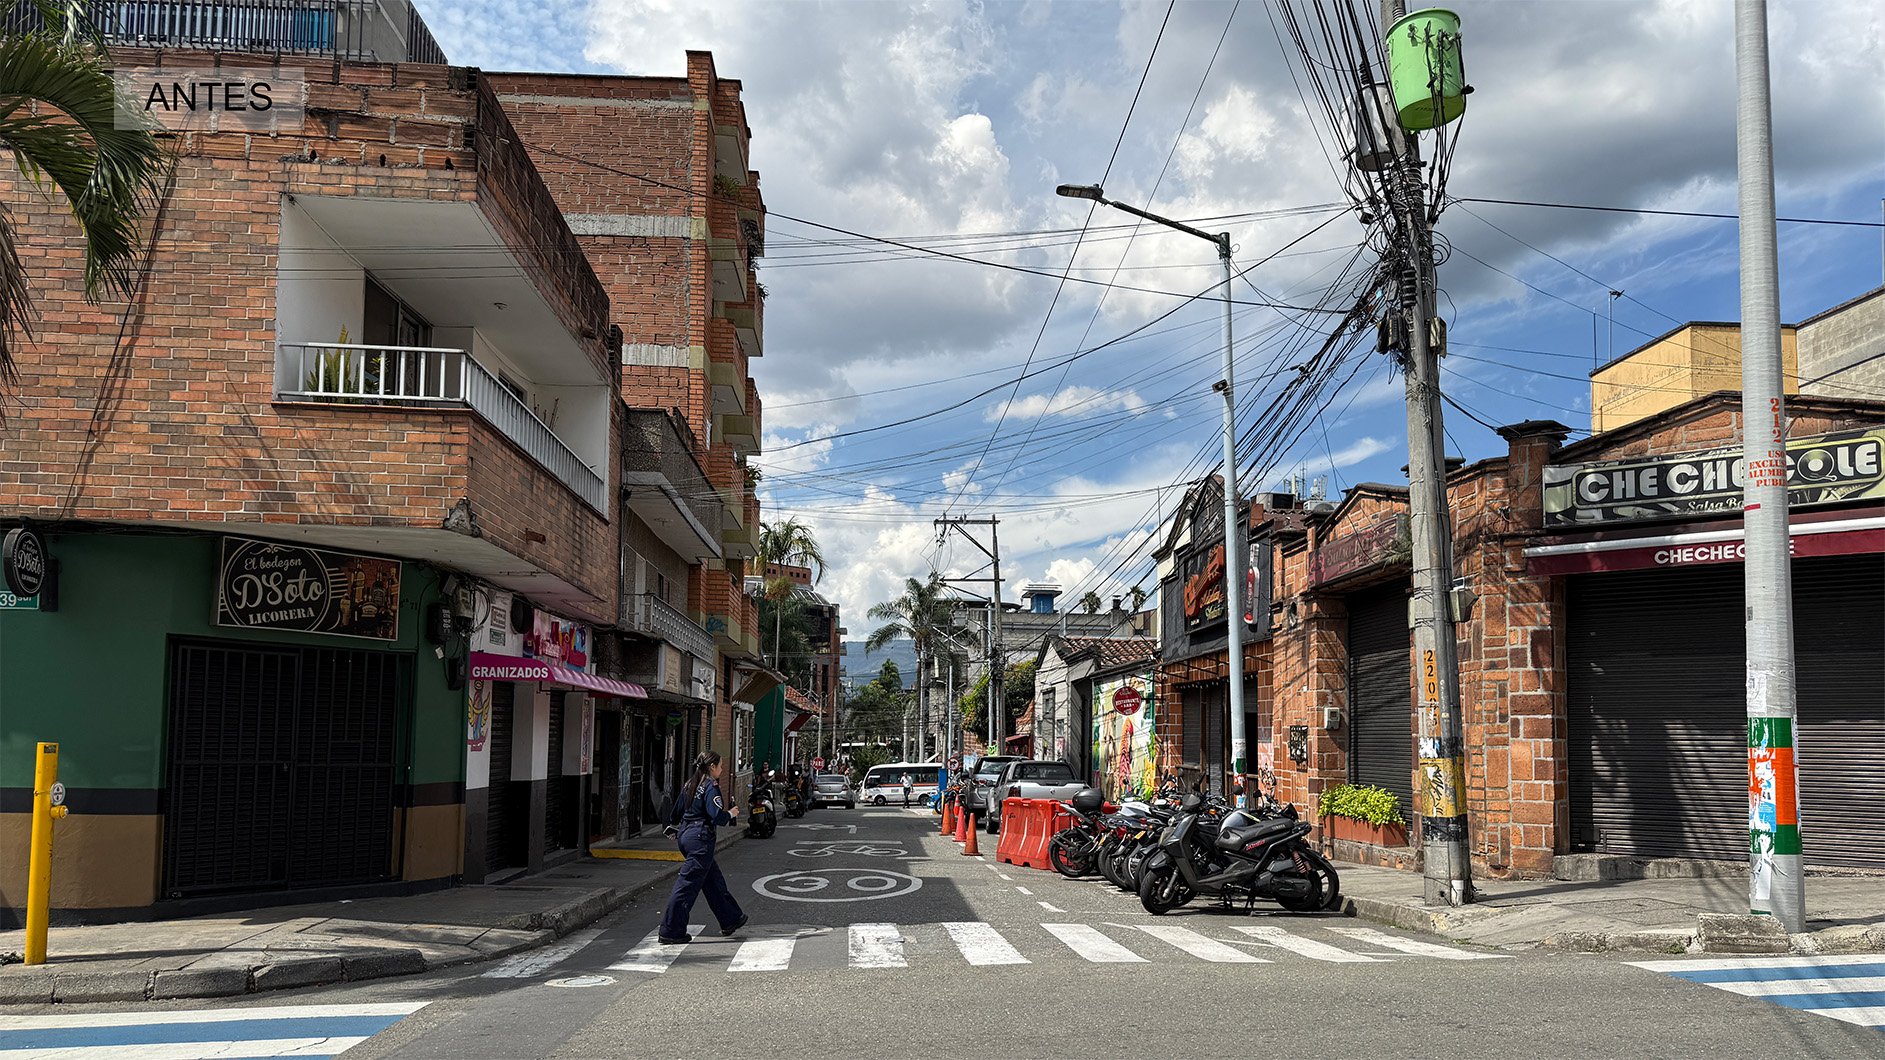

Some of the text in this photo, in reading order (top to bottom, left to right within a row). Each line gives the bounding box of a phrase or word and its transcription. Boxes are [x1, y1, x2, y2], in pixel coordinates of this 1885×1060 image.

[1579, 467, 1658, 502] CHE
[1686, 500, 1724, 512] Salsa
[244, 555, 302, 571] El bodegon
[249, 607, 315, 625] LICORERA
[472, 665, 549, 679] GRANIZADOS
[778, 875, 898, 893] 30
